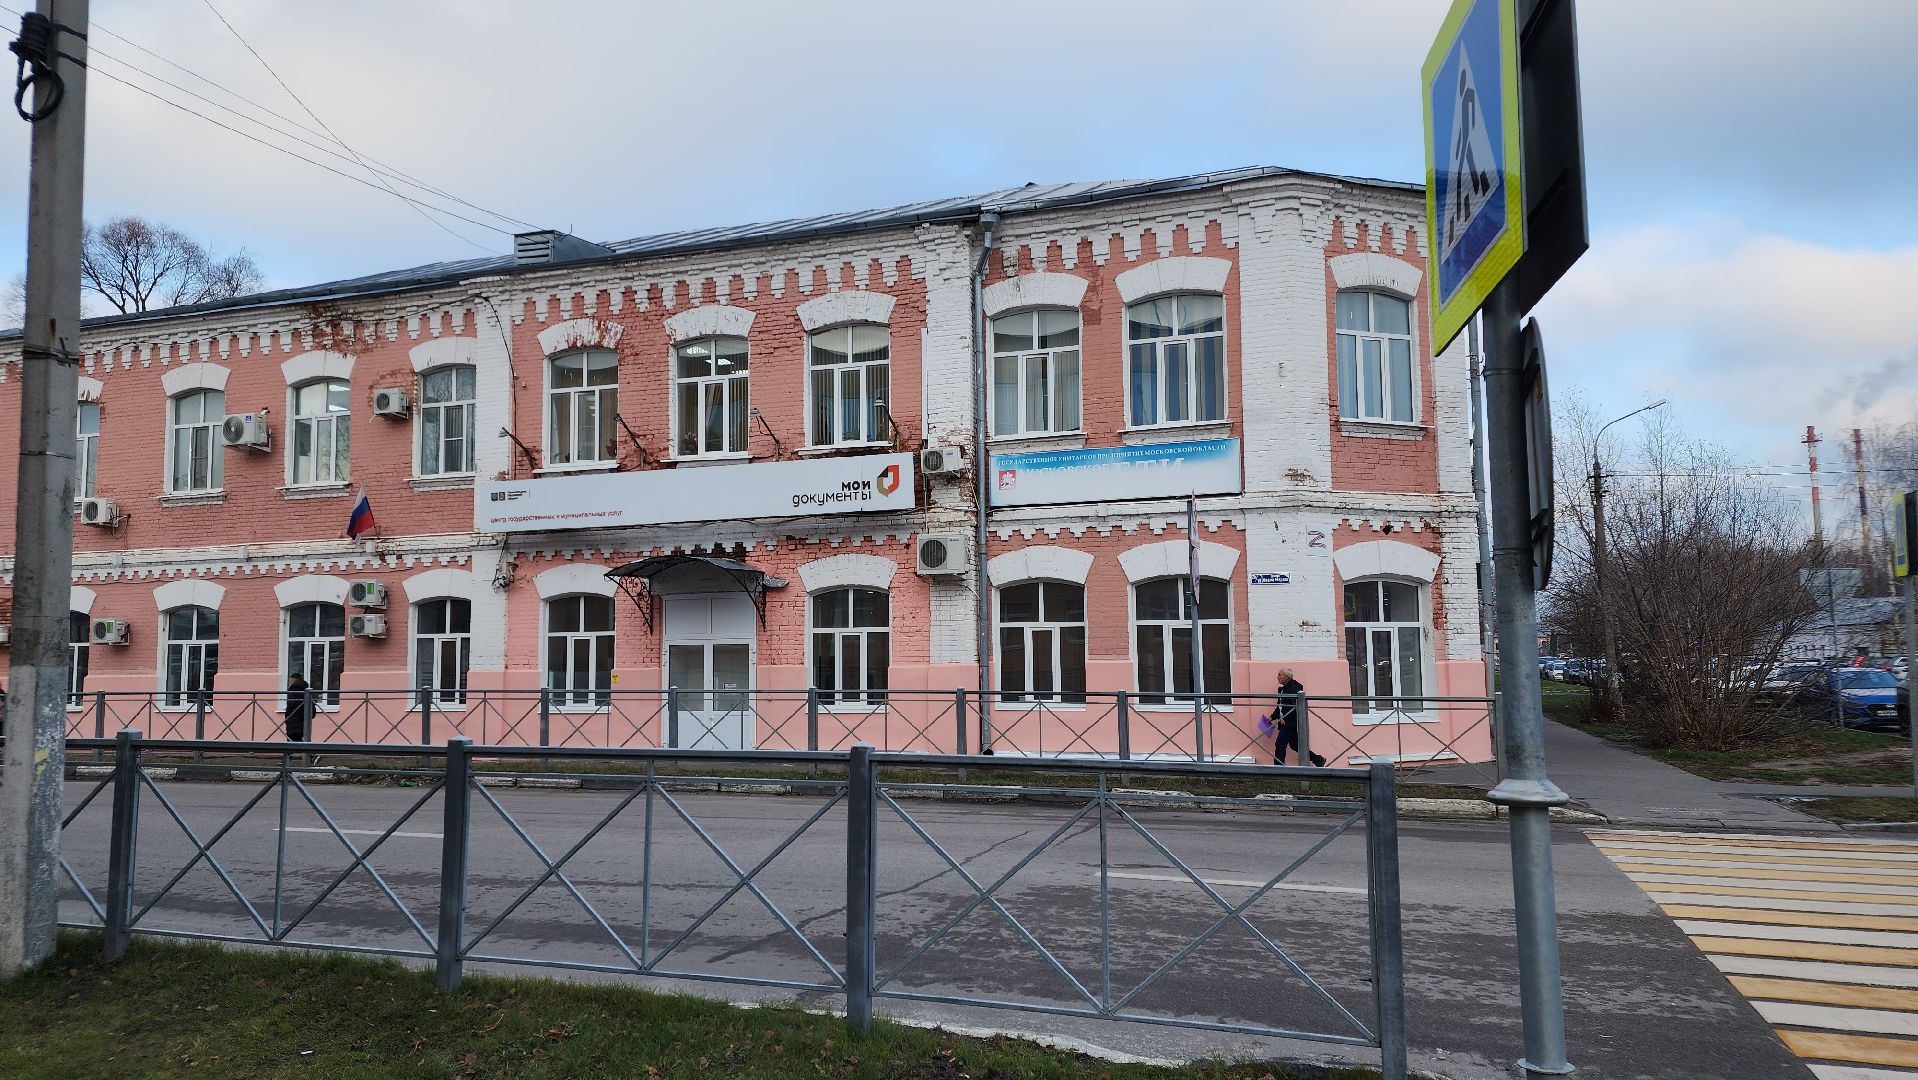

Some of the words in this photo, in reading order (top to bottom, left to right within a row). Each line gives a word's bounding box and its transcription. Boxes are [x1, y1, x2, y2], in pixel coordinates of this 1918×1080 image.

[998, 456, 1058, 466] ГОСУДАРСТВЕННОЕ
[1058, 454, 1096, 462] УНИТАРНОЕ
[1097, 450, 1144, 460] ПРЕДПРИЯТИЕ
[1145, 446, 1193, 456] МОСКОВСКОЙ
[1193, 444, 1227, 453] ОБЛАСТИ
[841, 480, 871, 491] мои
[792, 490, 872, 507] документы
[507, 514, 555, 523] государственных
[560, 511, 606, 520] муниципальных
